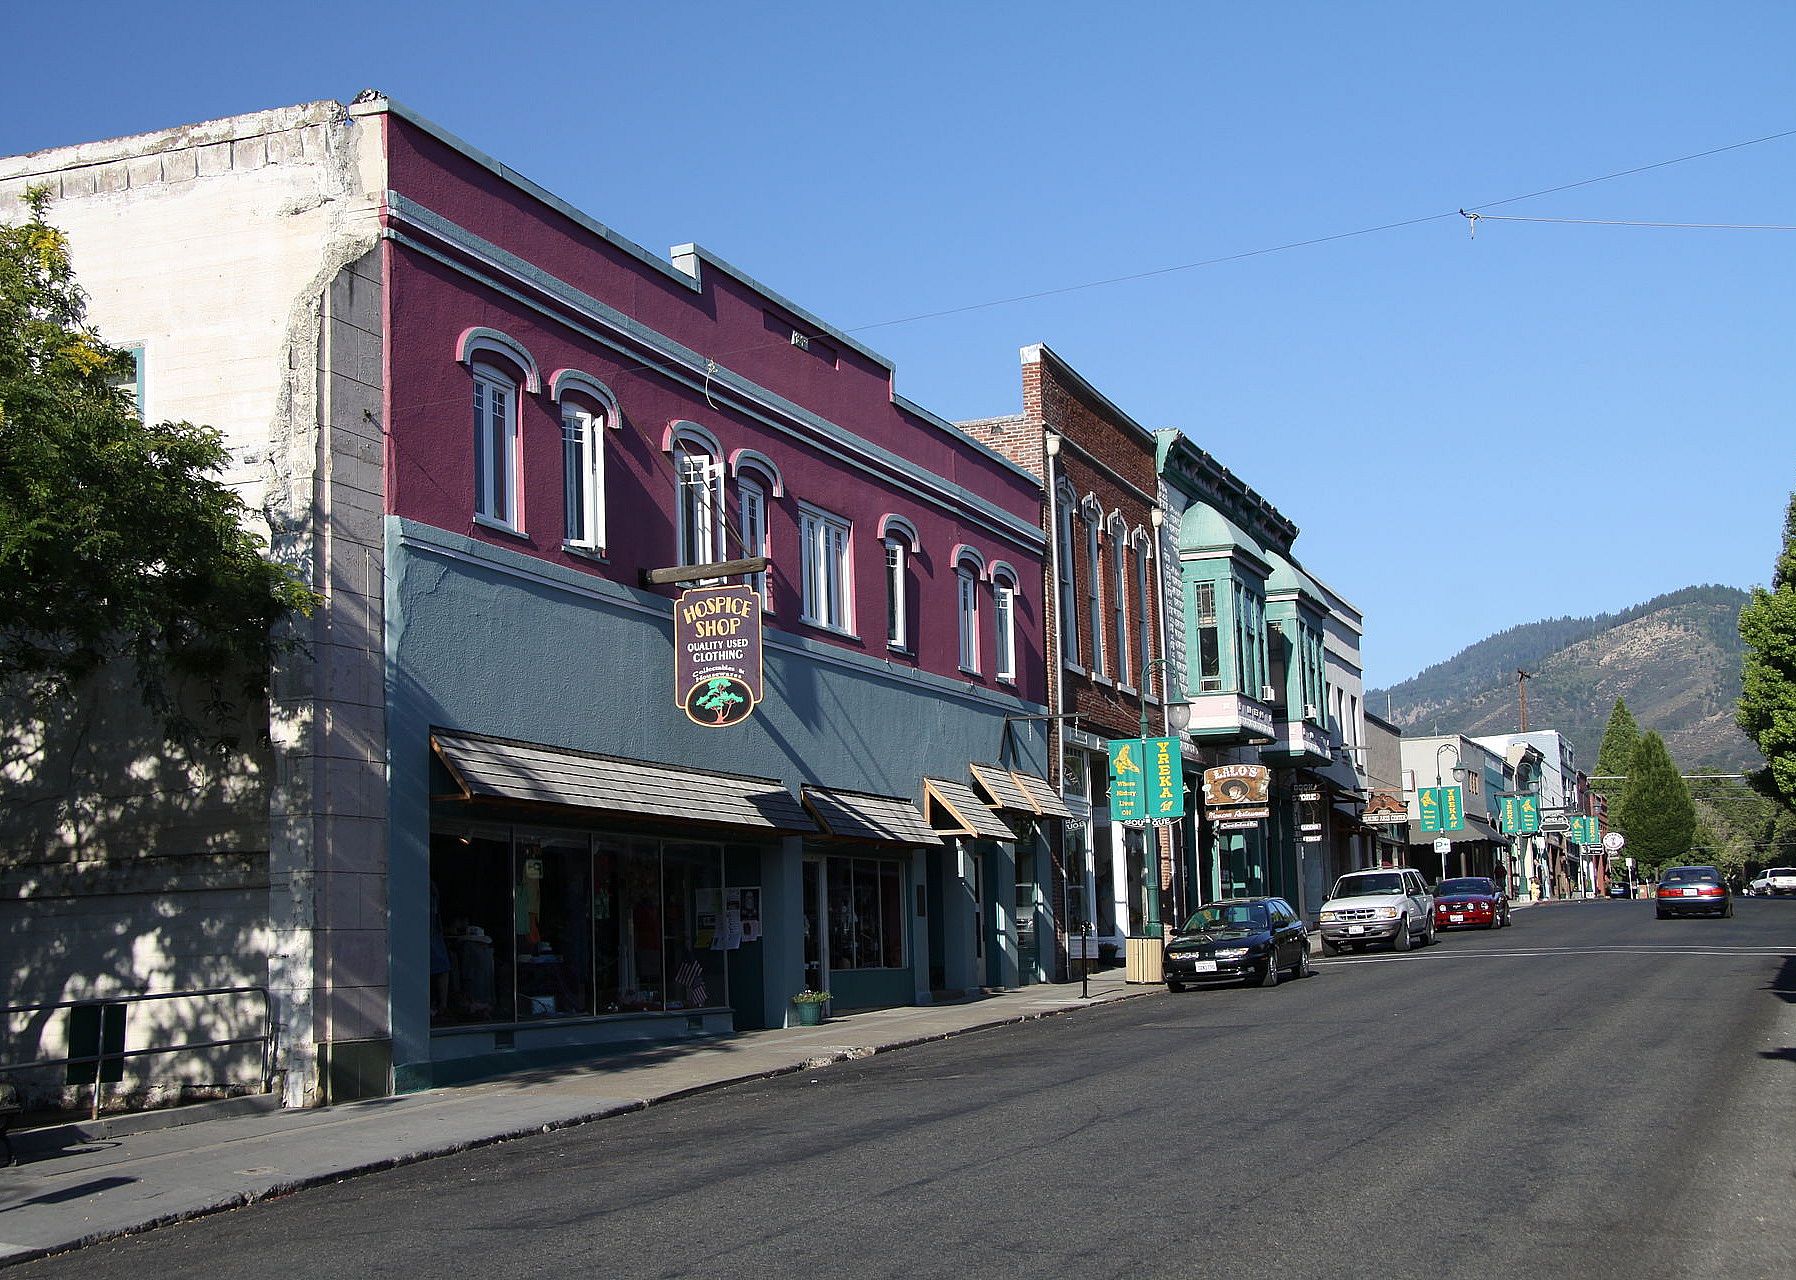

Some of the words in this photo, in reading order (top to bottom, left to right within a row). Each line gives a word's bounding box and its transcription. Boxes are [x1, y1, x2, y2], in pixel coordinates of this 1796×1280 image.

[683, 596, 753, 625] HOSPICE
[695, 617, 741, 638] SHOP
[687, 640, 724, 653] QUALITY
[726, 638, 749, 649] USED
[692, 649, 744, 663] CLOTHING
[1157, 742, 1173, 798] YREKA
[1213, 766, 1258, 780] LALO'S
[1123, 817, 1171, 827] BOUQUE
